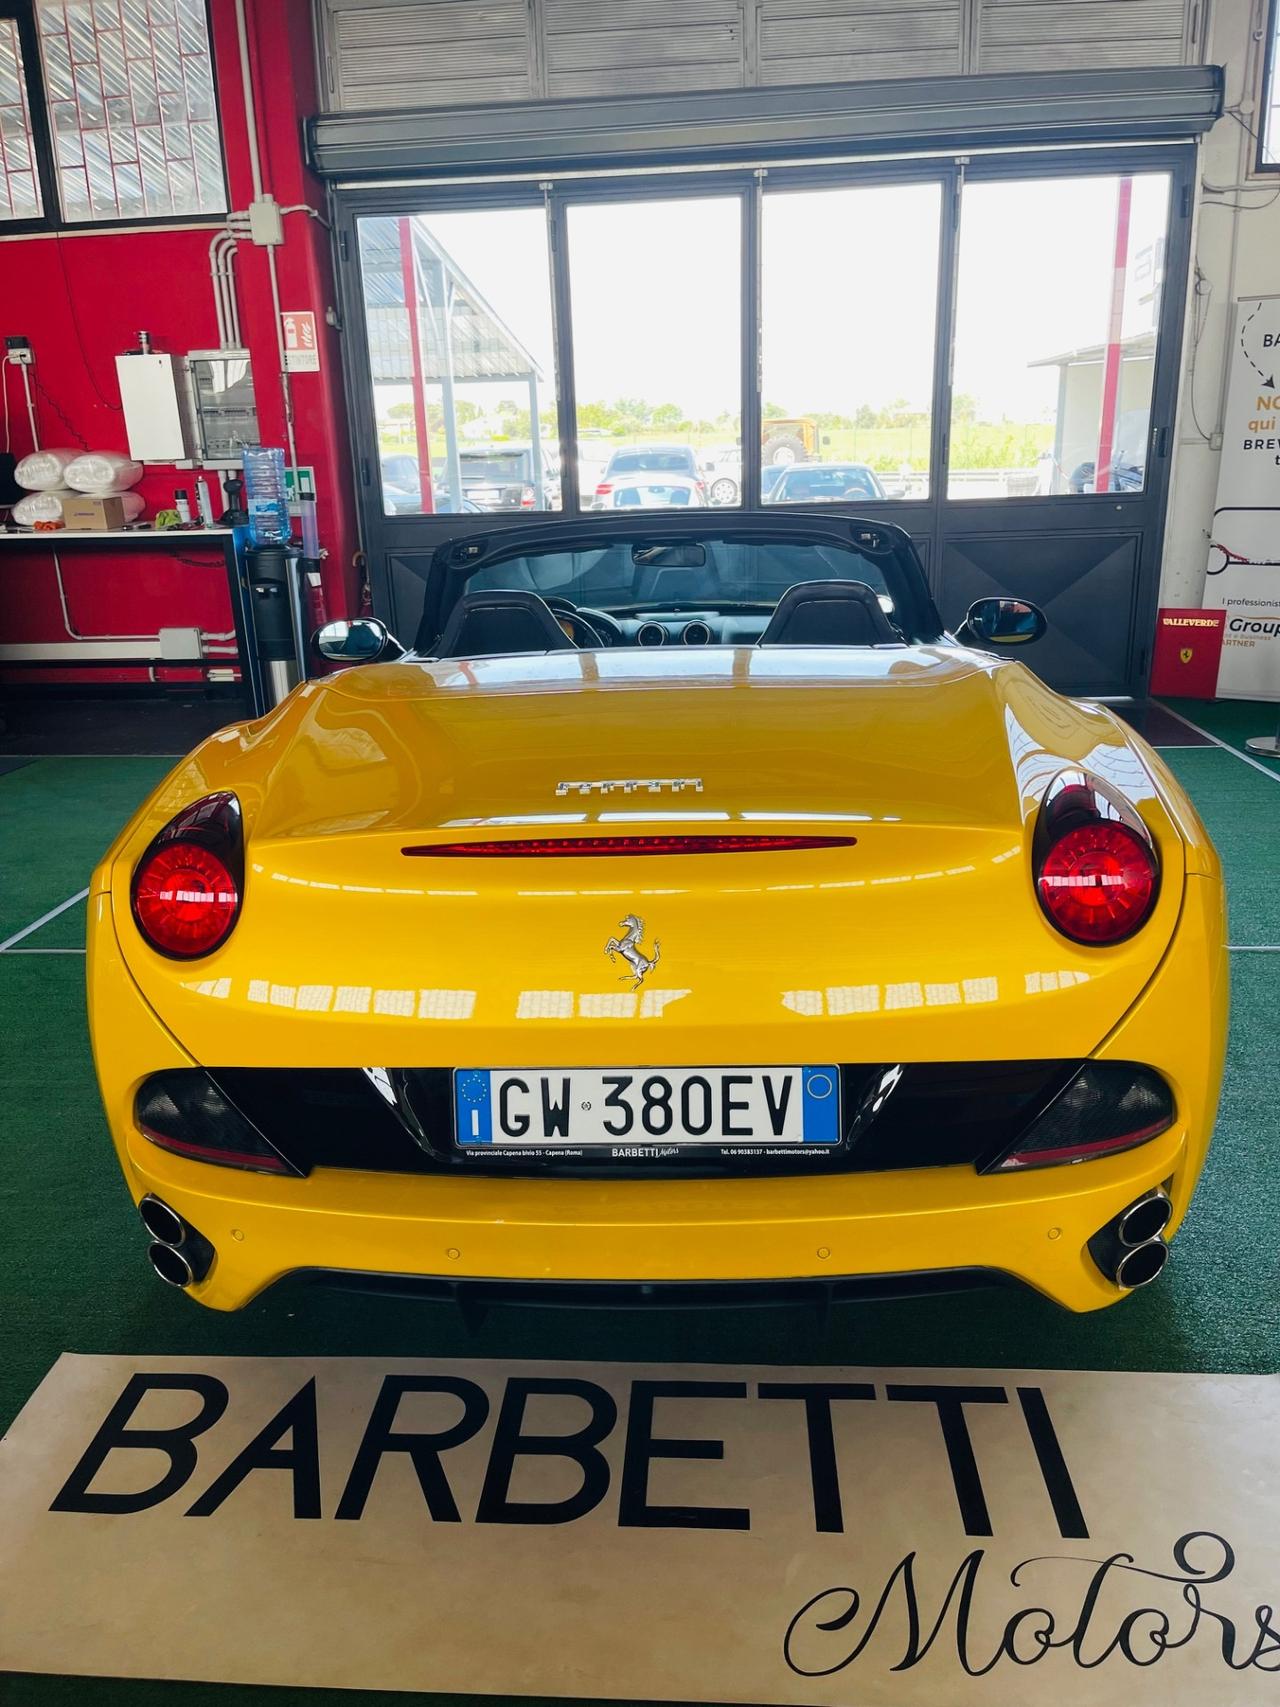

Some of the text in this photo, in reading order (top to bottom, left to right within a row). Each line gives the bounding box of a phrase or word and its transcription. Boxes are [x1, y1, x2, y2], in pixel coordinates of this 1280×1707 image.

[1247, 416, 1276, 433] qui
[1162, 617, 1220, 628] VALLEVERDE
[499, 1074, 794, 1138] GW 380EV
[611, 1148, 658, 1157] BARBETTI
[49, 1372, 1090, 1540] BARBETTI
[784, 1531, 1280, 1677] Motors
